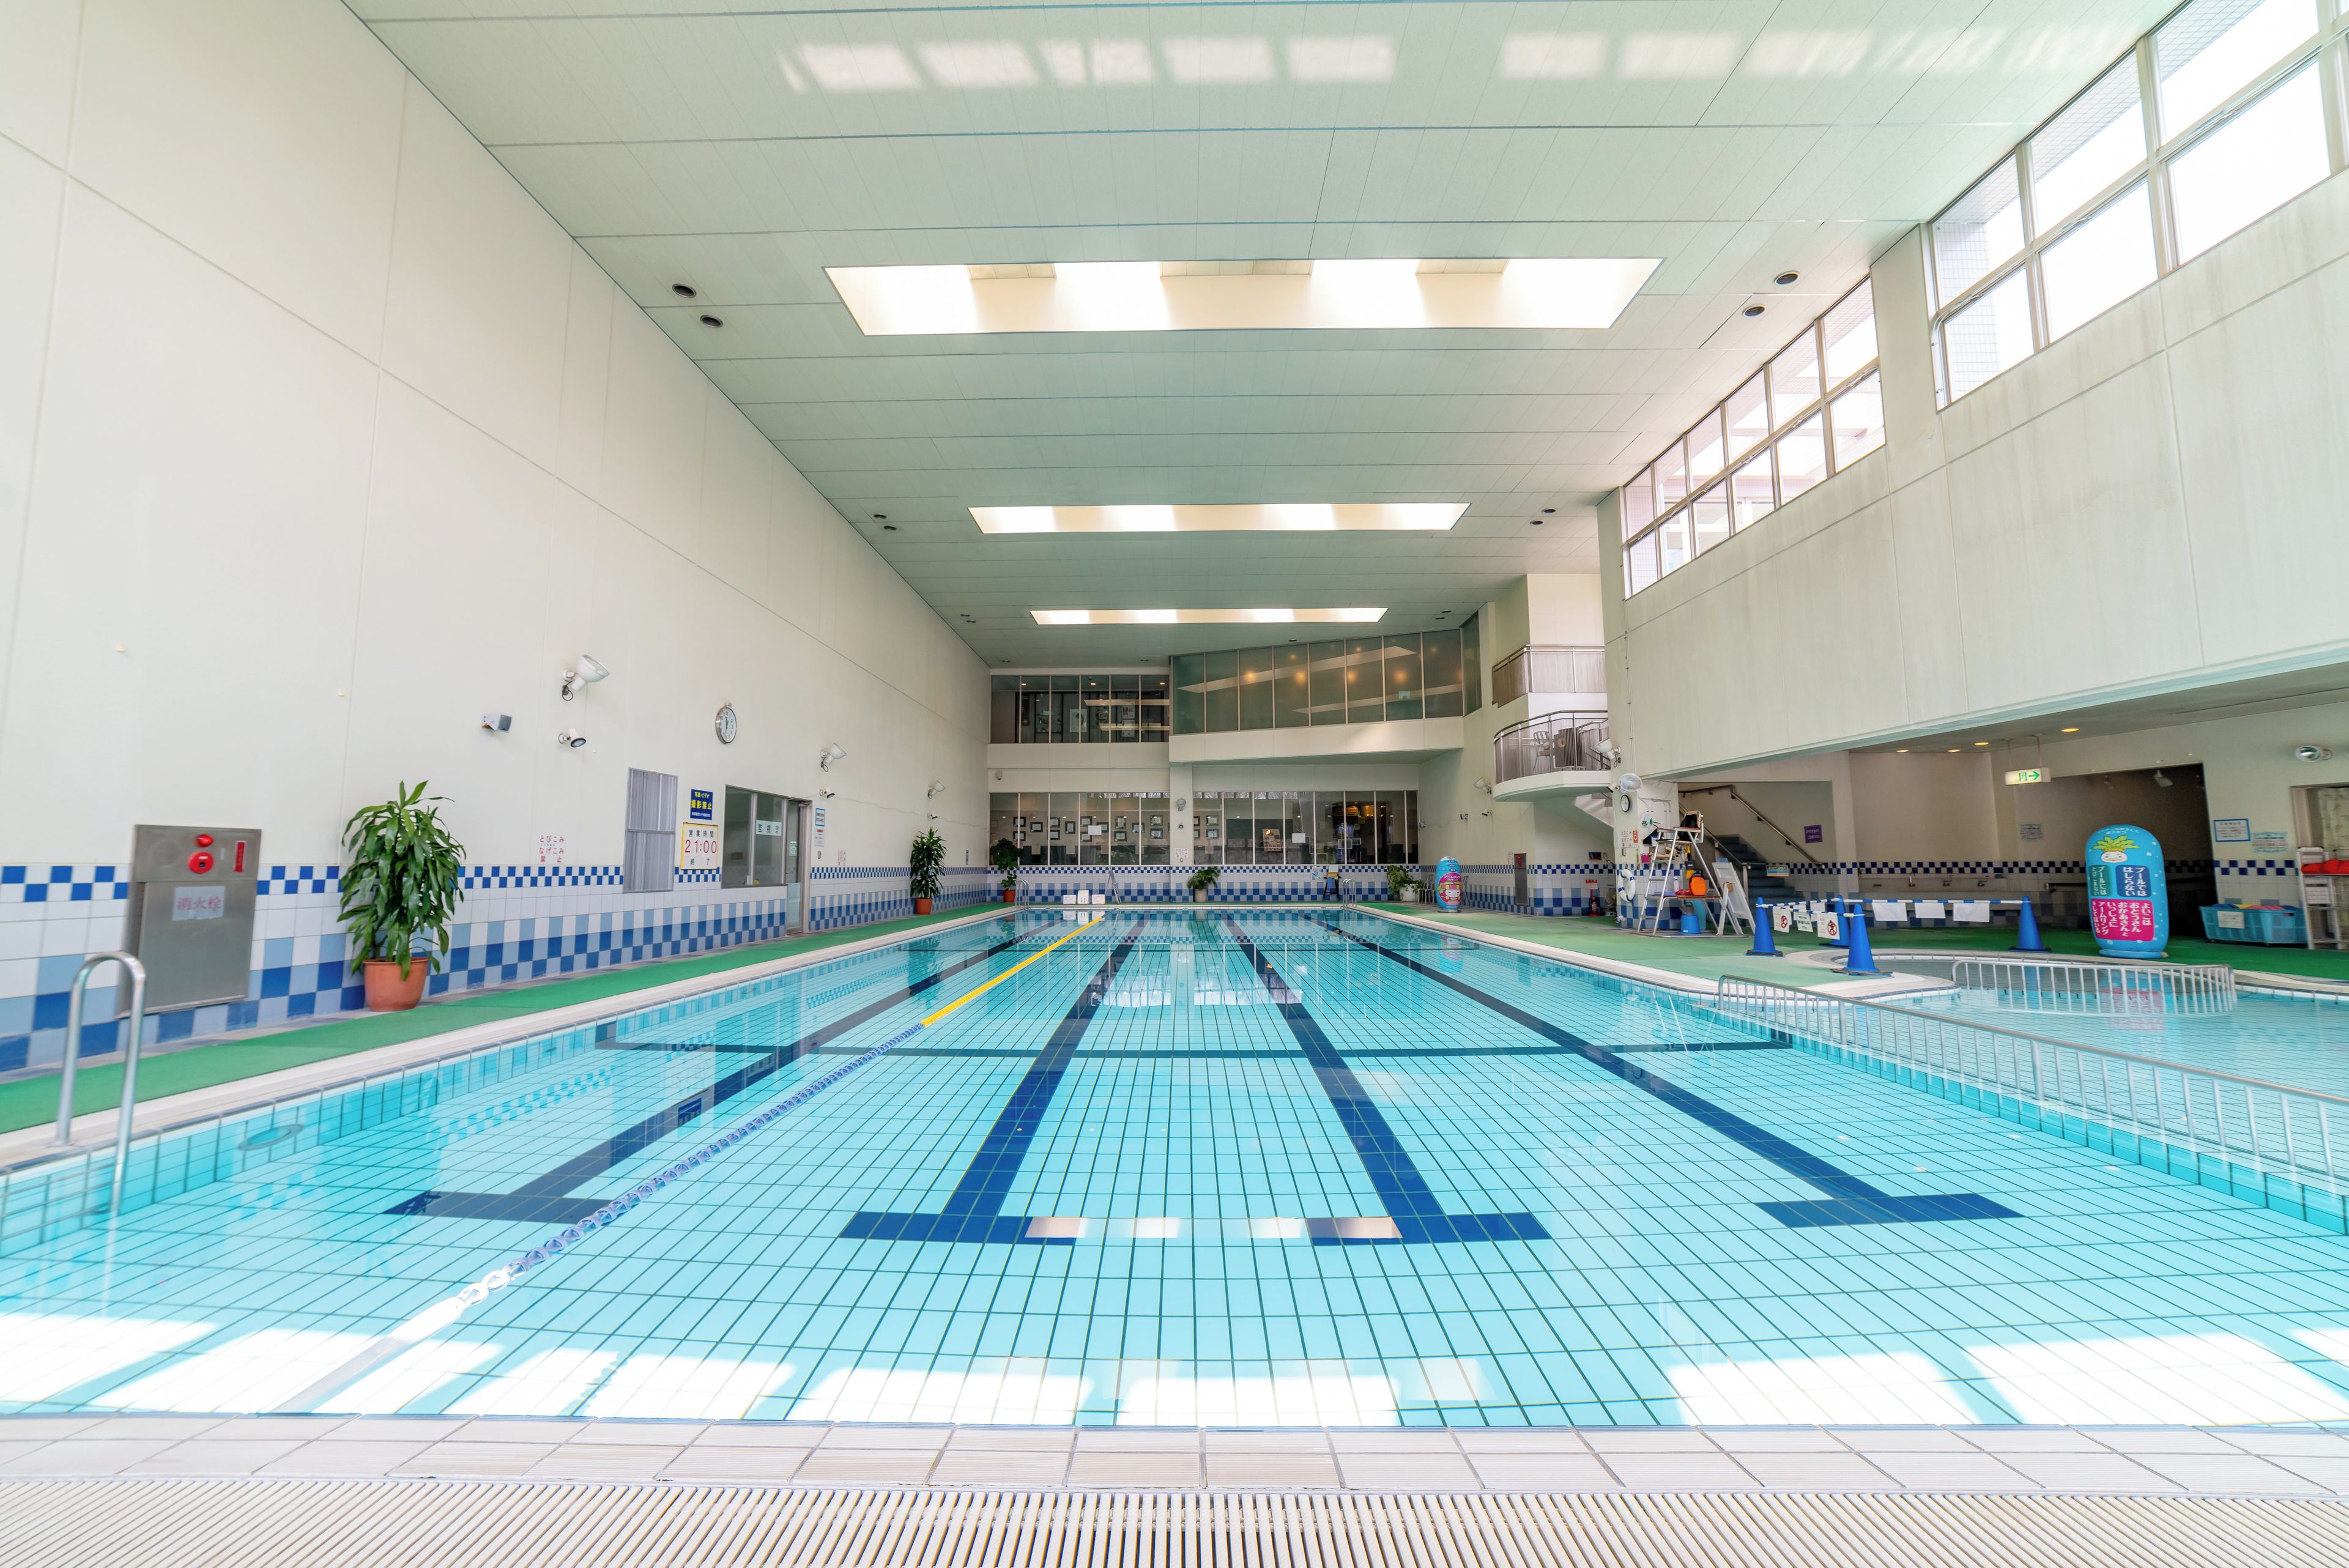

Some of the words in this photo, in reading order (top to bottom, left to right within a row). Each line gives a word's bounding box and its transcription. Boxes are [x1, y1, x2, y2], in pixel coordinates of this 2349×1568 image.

[691, 799, 712, 810] 撮影禁止
[685, 839, 717, 853] 21:00
[2098, 866, 2107, 896] プールには
[2123, 866, 2136, 896] はしらない
[2136, 867, 2148, 896] プールでは
[177, 896, 222, 912] 消火栓
[2098, 901, 2109, 935] アームリング
[2107, 901, 2119, 927] いっしょに
[2129, 902, 2142, 933] おとうさん
[2141, 902, 2153, 926] よいこは
[2118, 902, 2130, 937] おかあさんと
